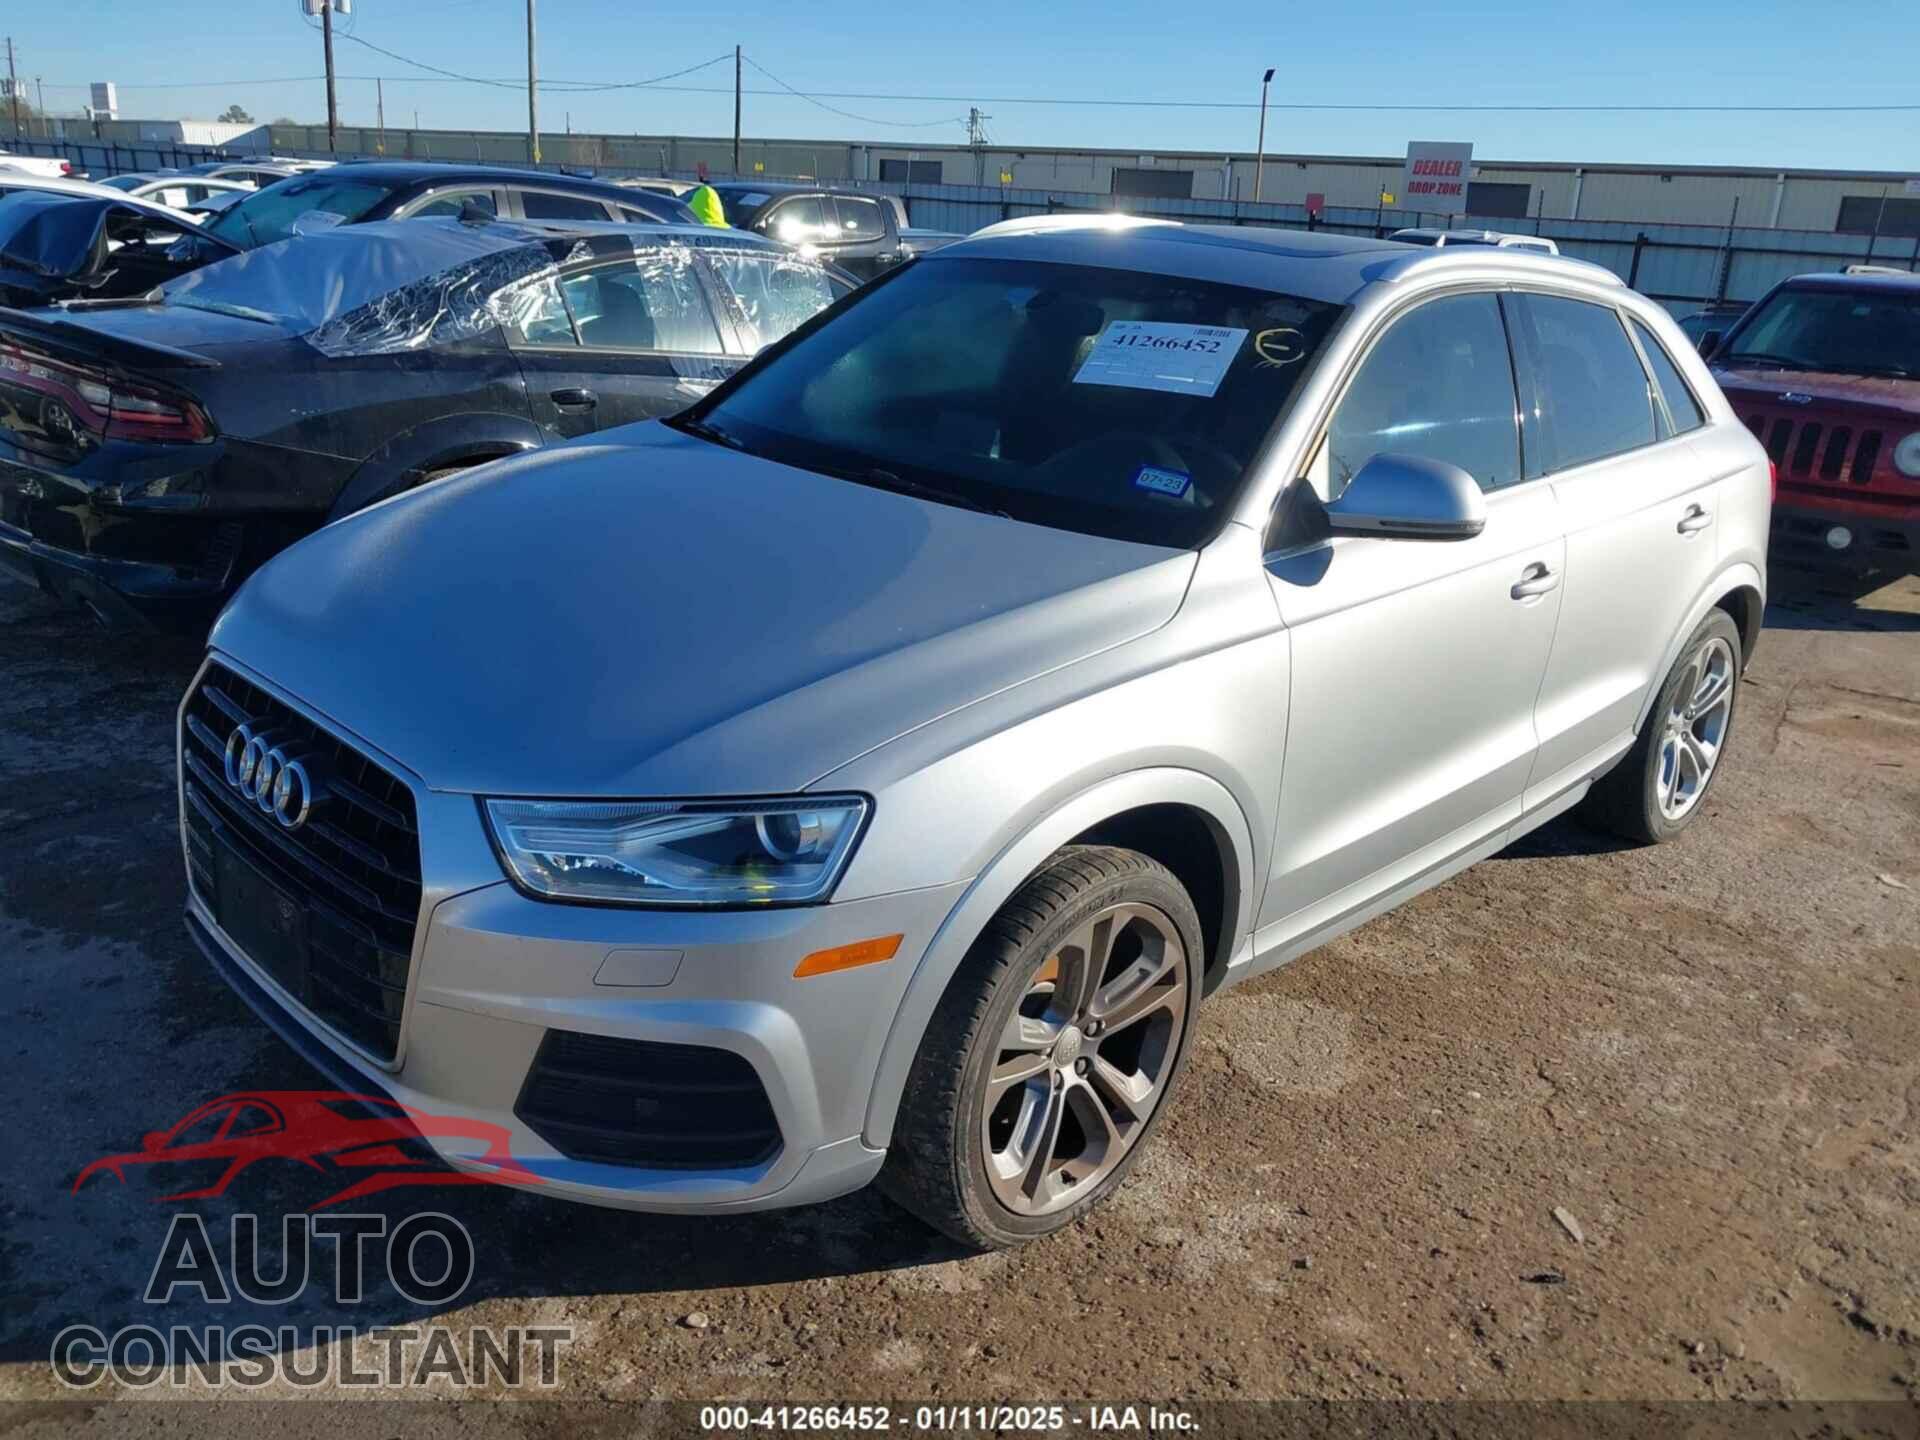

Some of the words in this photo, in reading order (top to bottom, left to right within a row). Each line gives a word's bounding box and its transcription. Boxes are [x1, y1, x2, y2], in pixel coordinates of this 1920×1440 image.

[1412, 160, 1463, 176] DEALER
[1408, 181, 1436, 193] DROP
[1437, 183, 1463, 195] ZONE
[1112, 334, 1221, 353] 41266452
